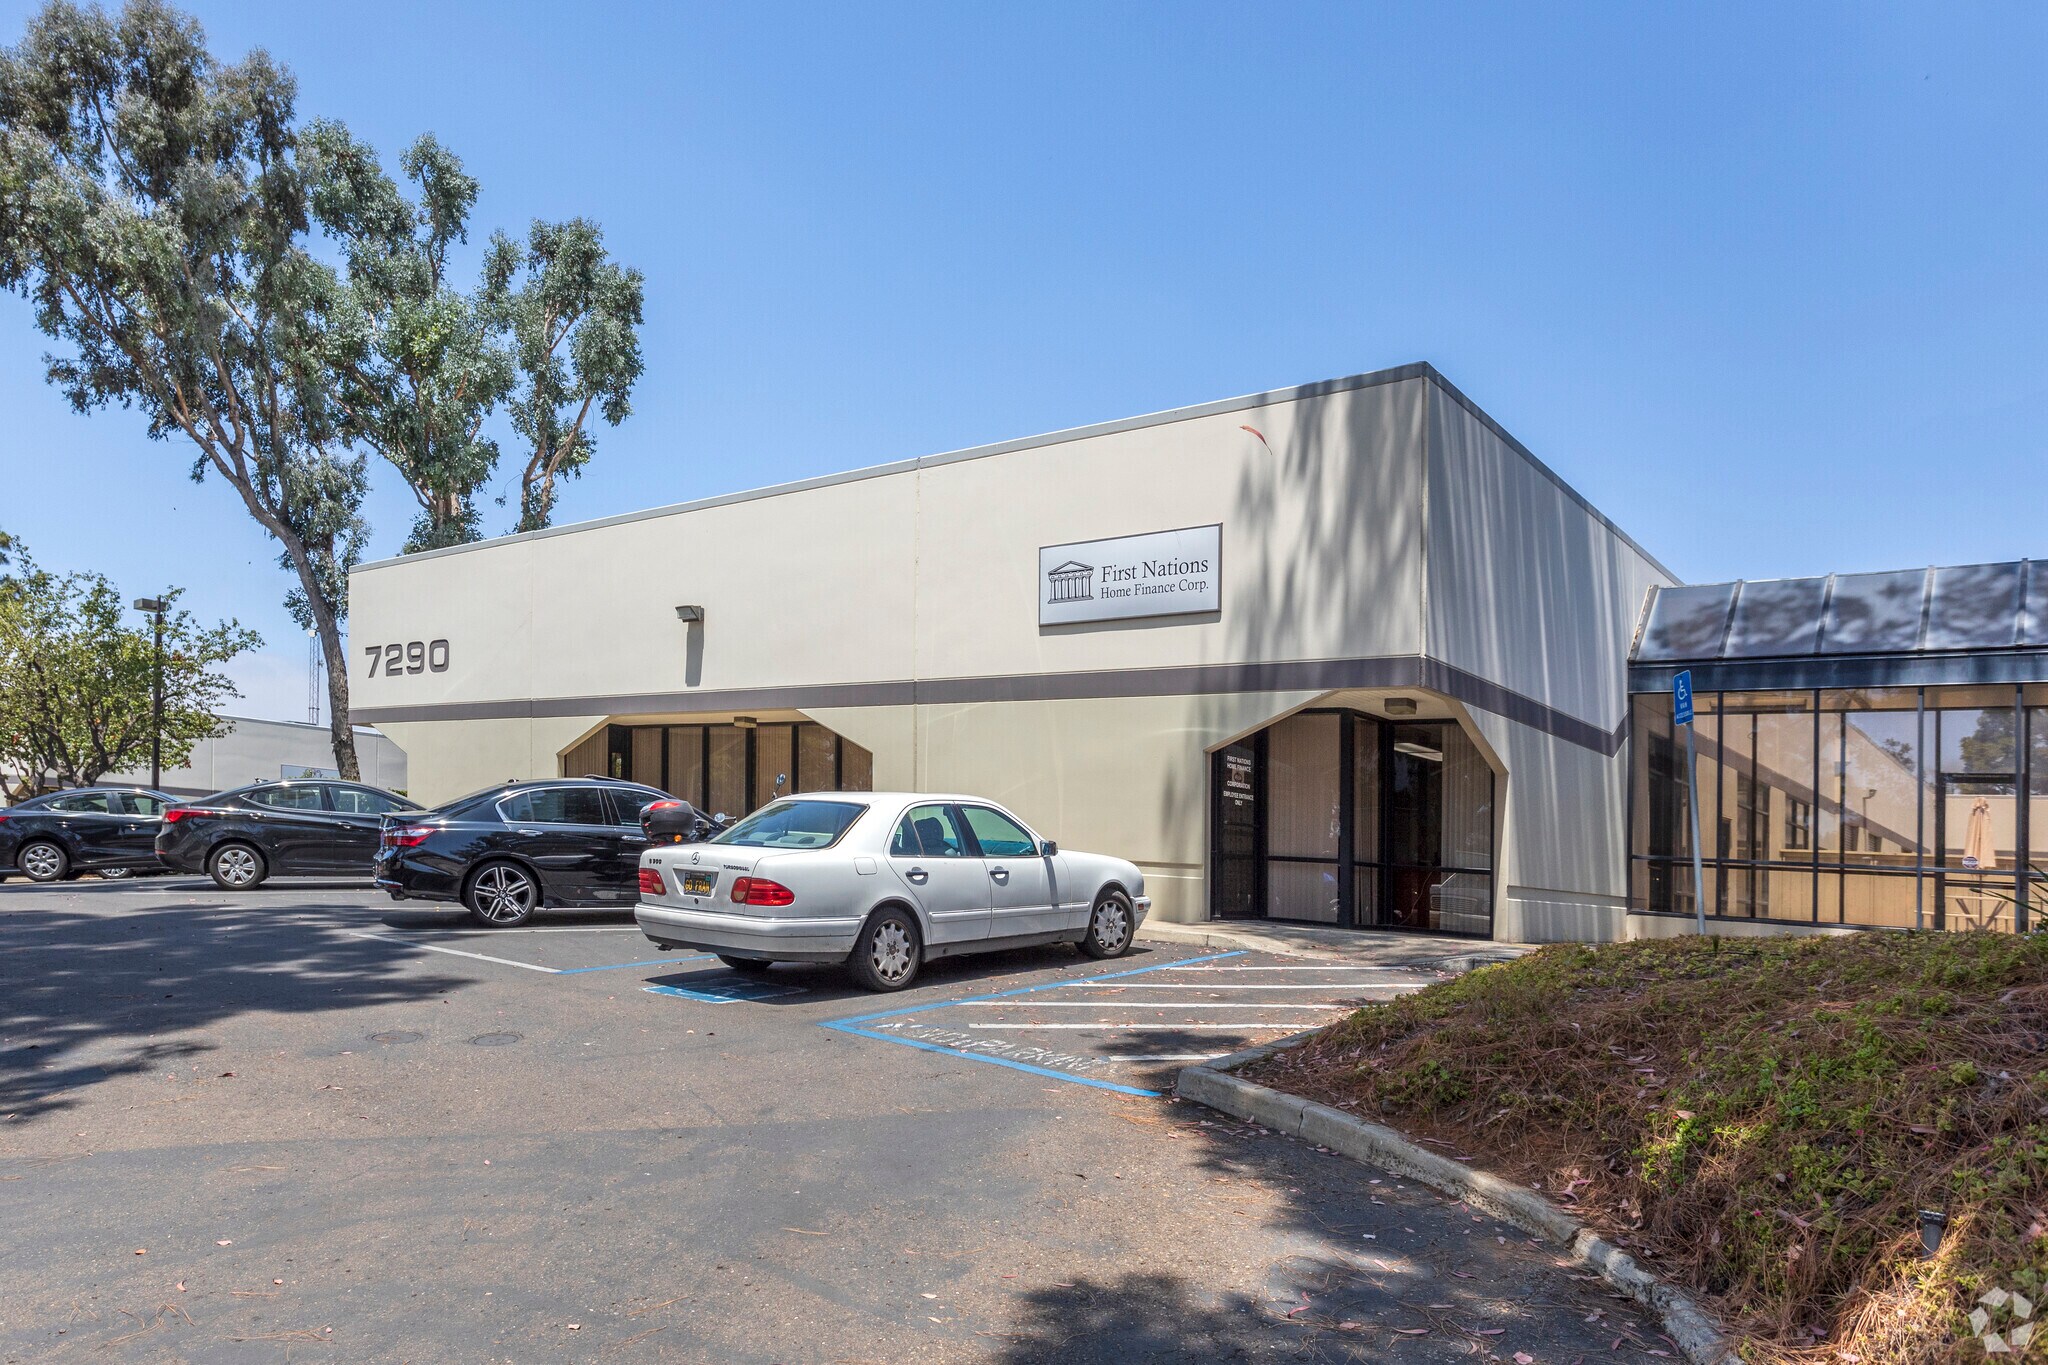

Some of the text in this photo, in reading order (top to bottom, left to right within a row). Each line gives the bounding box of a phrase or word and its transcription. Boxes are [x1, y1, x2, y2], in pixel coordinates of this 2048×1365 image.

[1101, 557, 1209, 583] First Nations
[1100, 579, 1209, 599] Home Finance Corp.
[365, 639, 449, 678] 7290
